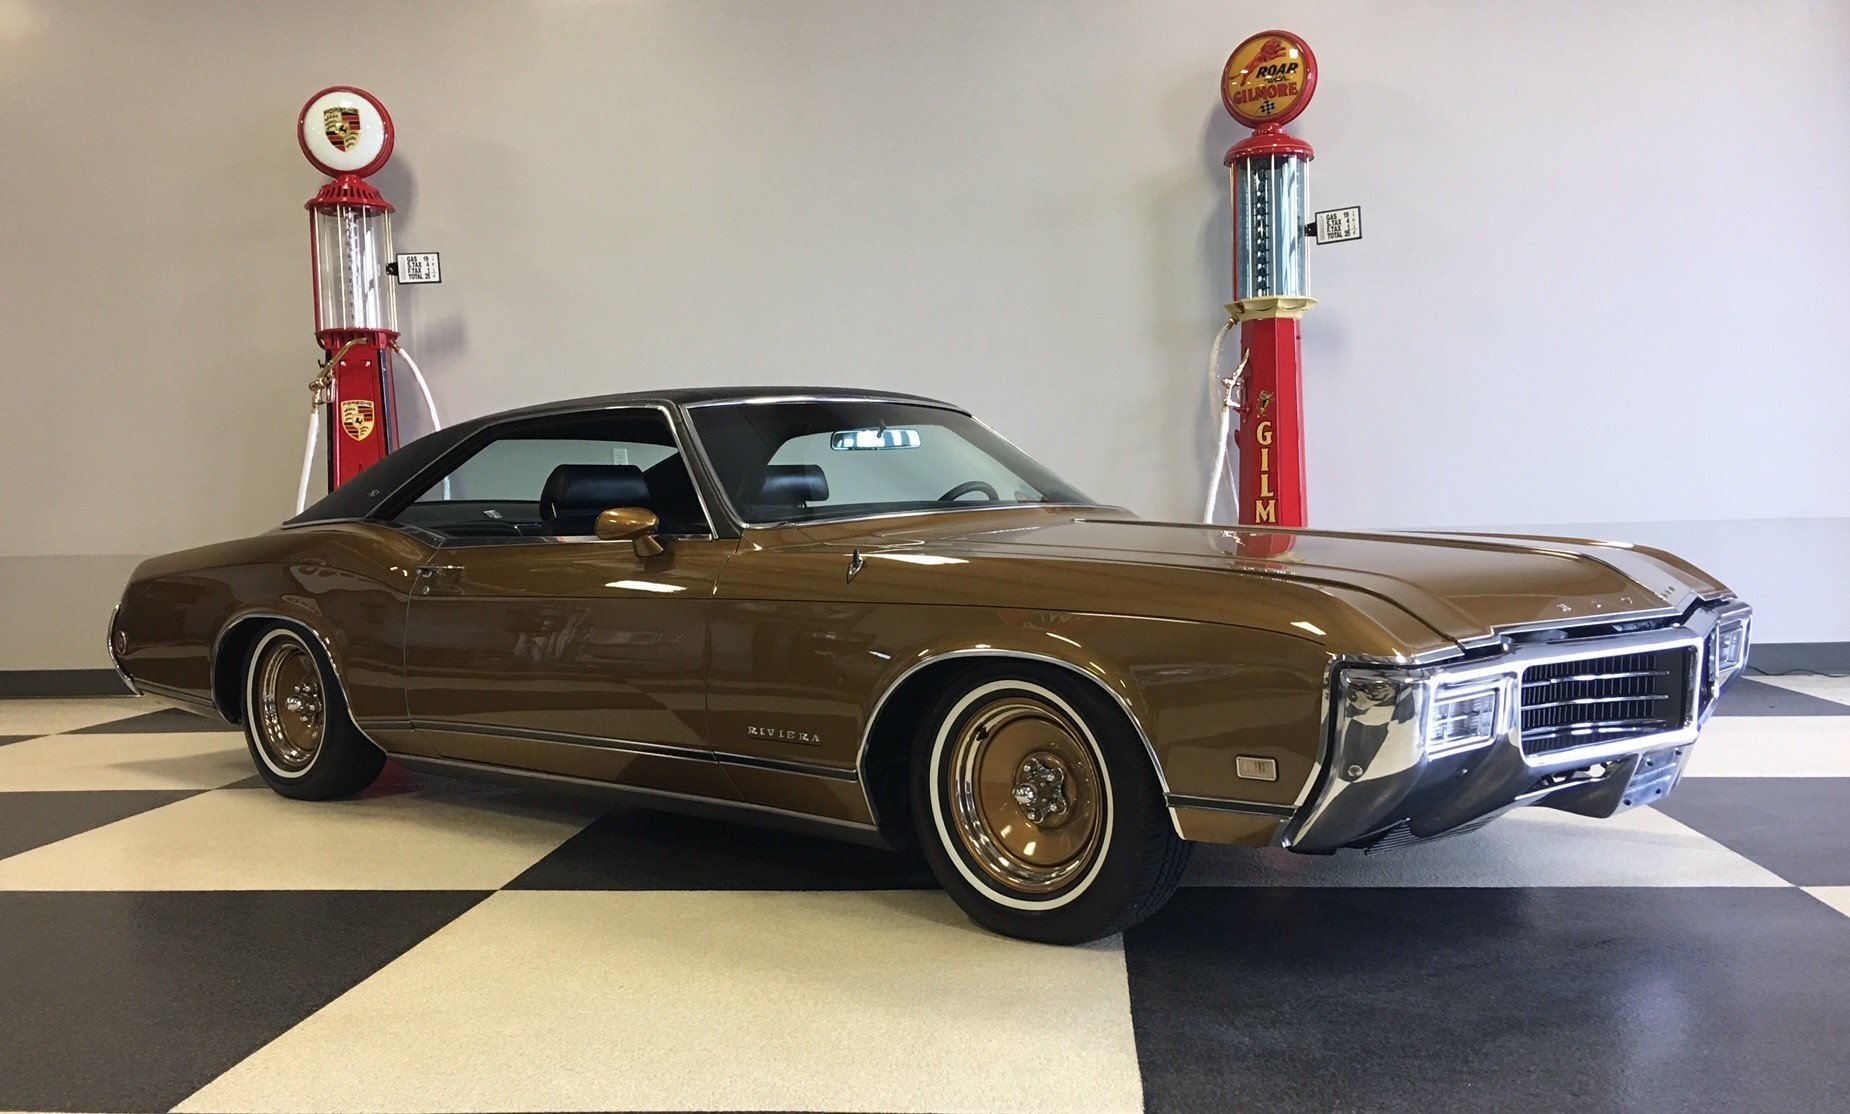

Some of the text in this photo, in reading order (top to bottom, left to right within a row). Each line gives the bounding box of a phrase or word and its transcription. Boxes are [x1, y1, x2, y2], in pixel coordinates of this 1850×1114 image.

[1256, 62, 1299, 79] ROAR
[1232, 81, 1299, 105] GILMORE
[1327, 231, 1343, 239] TOTAL
[1254, 421, 1277, 524] GILM
[747, 726, 821, 742] RIVIERA
